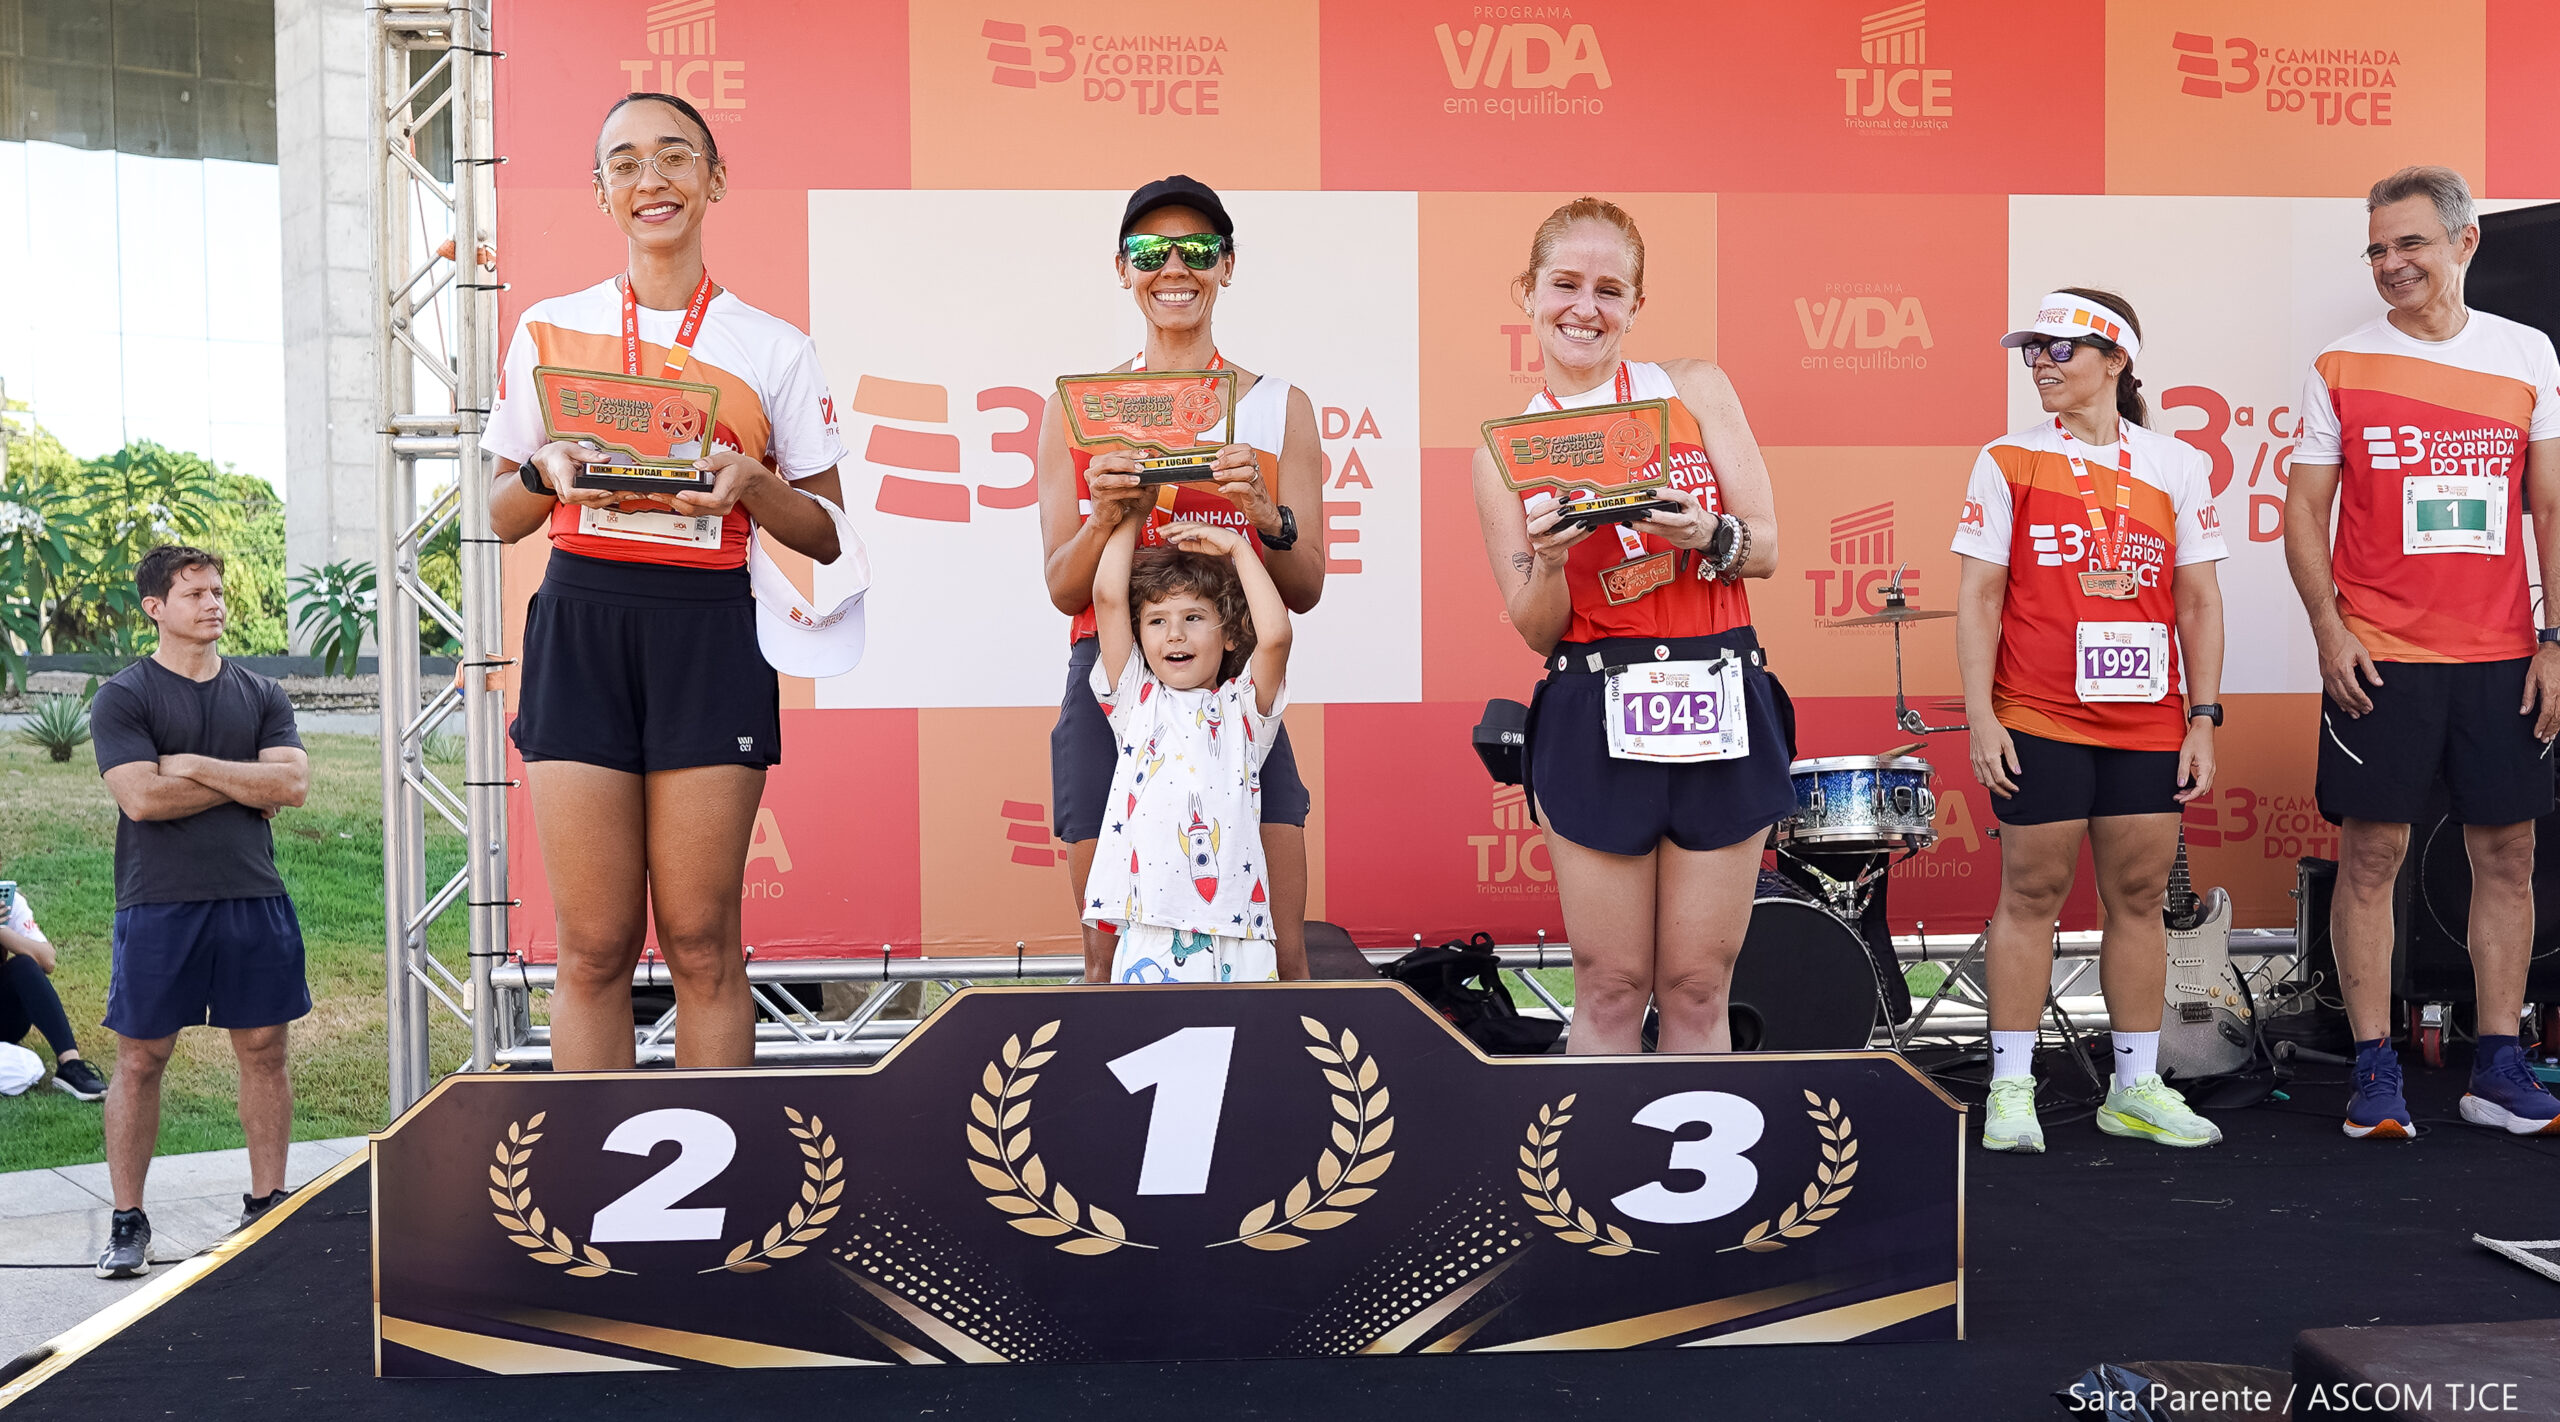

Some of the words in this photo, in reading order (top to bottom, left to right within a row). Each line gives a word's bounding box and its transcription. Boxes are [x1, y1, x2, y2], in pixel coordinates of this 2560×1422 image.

[1474, 6, 1573, 19] PROGRAMA
[1092, 35, 1228, 52] CAMINHADA
[1083, 53, 1224, 75] /CORRIDA
[1434, 23, 1613, 89] VIDA
[2275, 48, 2401, 66] CAMINHADA
[2266, 65, 2397, 88] /CORRIDA
[1084, 78, 1126, 102] DO
[1130, 80, 1219, 115] TJCE
[1836, 69, 1952, 117] TJCE
[1444, 97, 1478, 114] em
[1484, 91, 1603, 120] equilíbrio
[2266, 89, 2305, 112] DO
[2310, 92, 2392, 126] TJCE
[1845, 118, 1890, 129] Tribunal
[1893, 118, 1908, 129] de
[1911, 118, 1949, 131] Justiça
[1825, 283, 1903, 294] PROGRAMA
[1794, 296, 1935, 350] VIDA
[1801, 355, 1828, 369] em
[1833, 350, 1927, 375] equilíbrio
[1509, 374, 1545, 384] Tribun
[600, 397, 654, 410] CAMINHADA
[595, 412, 614, 424] DO
[615, 416, 649, 432] TJCE
[1121, 412, 1138, 423] DO
[1140, 411, 1173, 427] TJCE
[2433, 428, 2519, 442] CAMINHADA
[977, 386, 1046, 509] 3
[1551, 452, 1567, 465] DO
[1570, 449, 1605, 466] TJCE
[634, 468, 662, 477] LUGAR
[1166, 457, 1193, 467] LUGAR
[2430, 458, 2459, 475] DO
[1597, 497, 1626, 509] LUGAR
[2446, 501, 2459, 528] 1
[2087, 648, 2149, 677] 1992
[1611, 676, 1620, 702] 10KM
[1626, 694, 1717, 733] 1943
[1467, 834, 1557, 882] TJC
[2264, 836, 2302, 859] DO
[1476, 883, 1522, 894] Tribunal
[1526, 884, 1540, 894] de
[1106, 1027, 1236, 1195] 1
[1610, 1090, 1765, 1224] 3
[590, 1108, 737, 1242] 2
